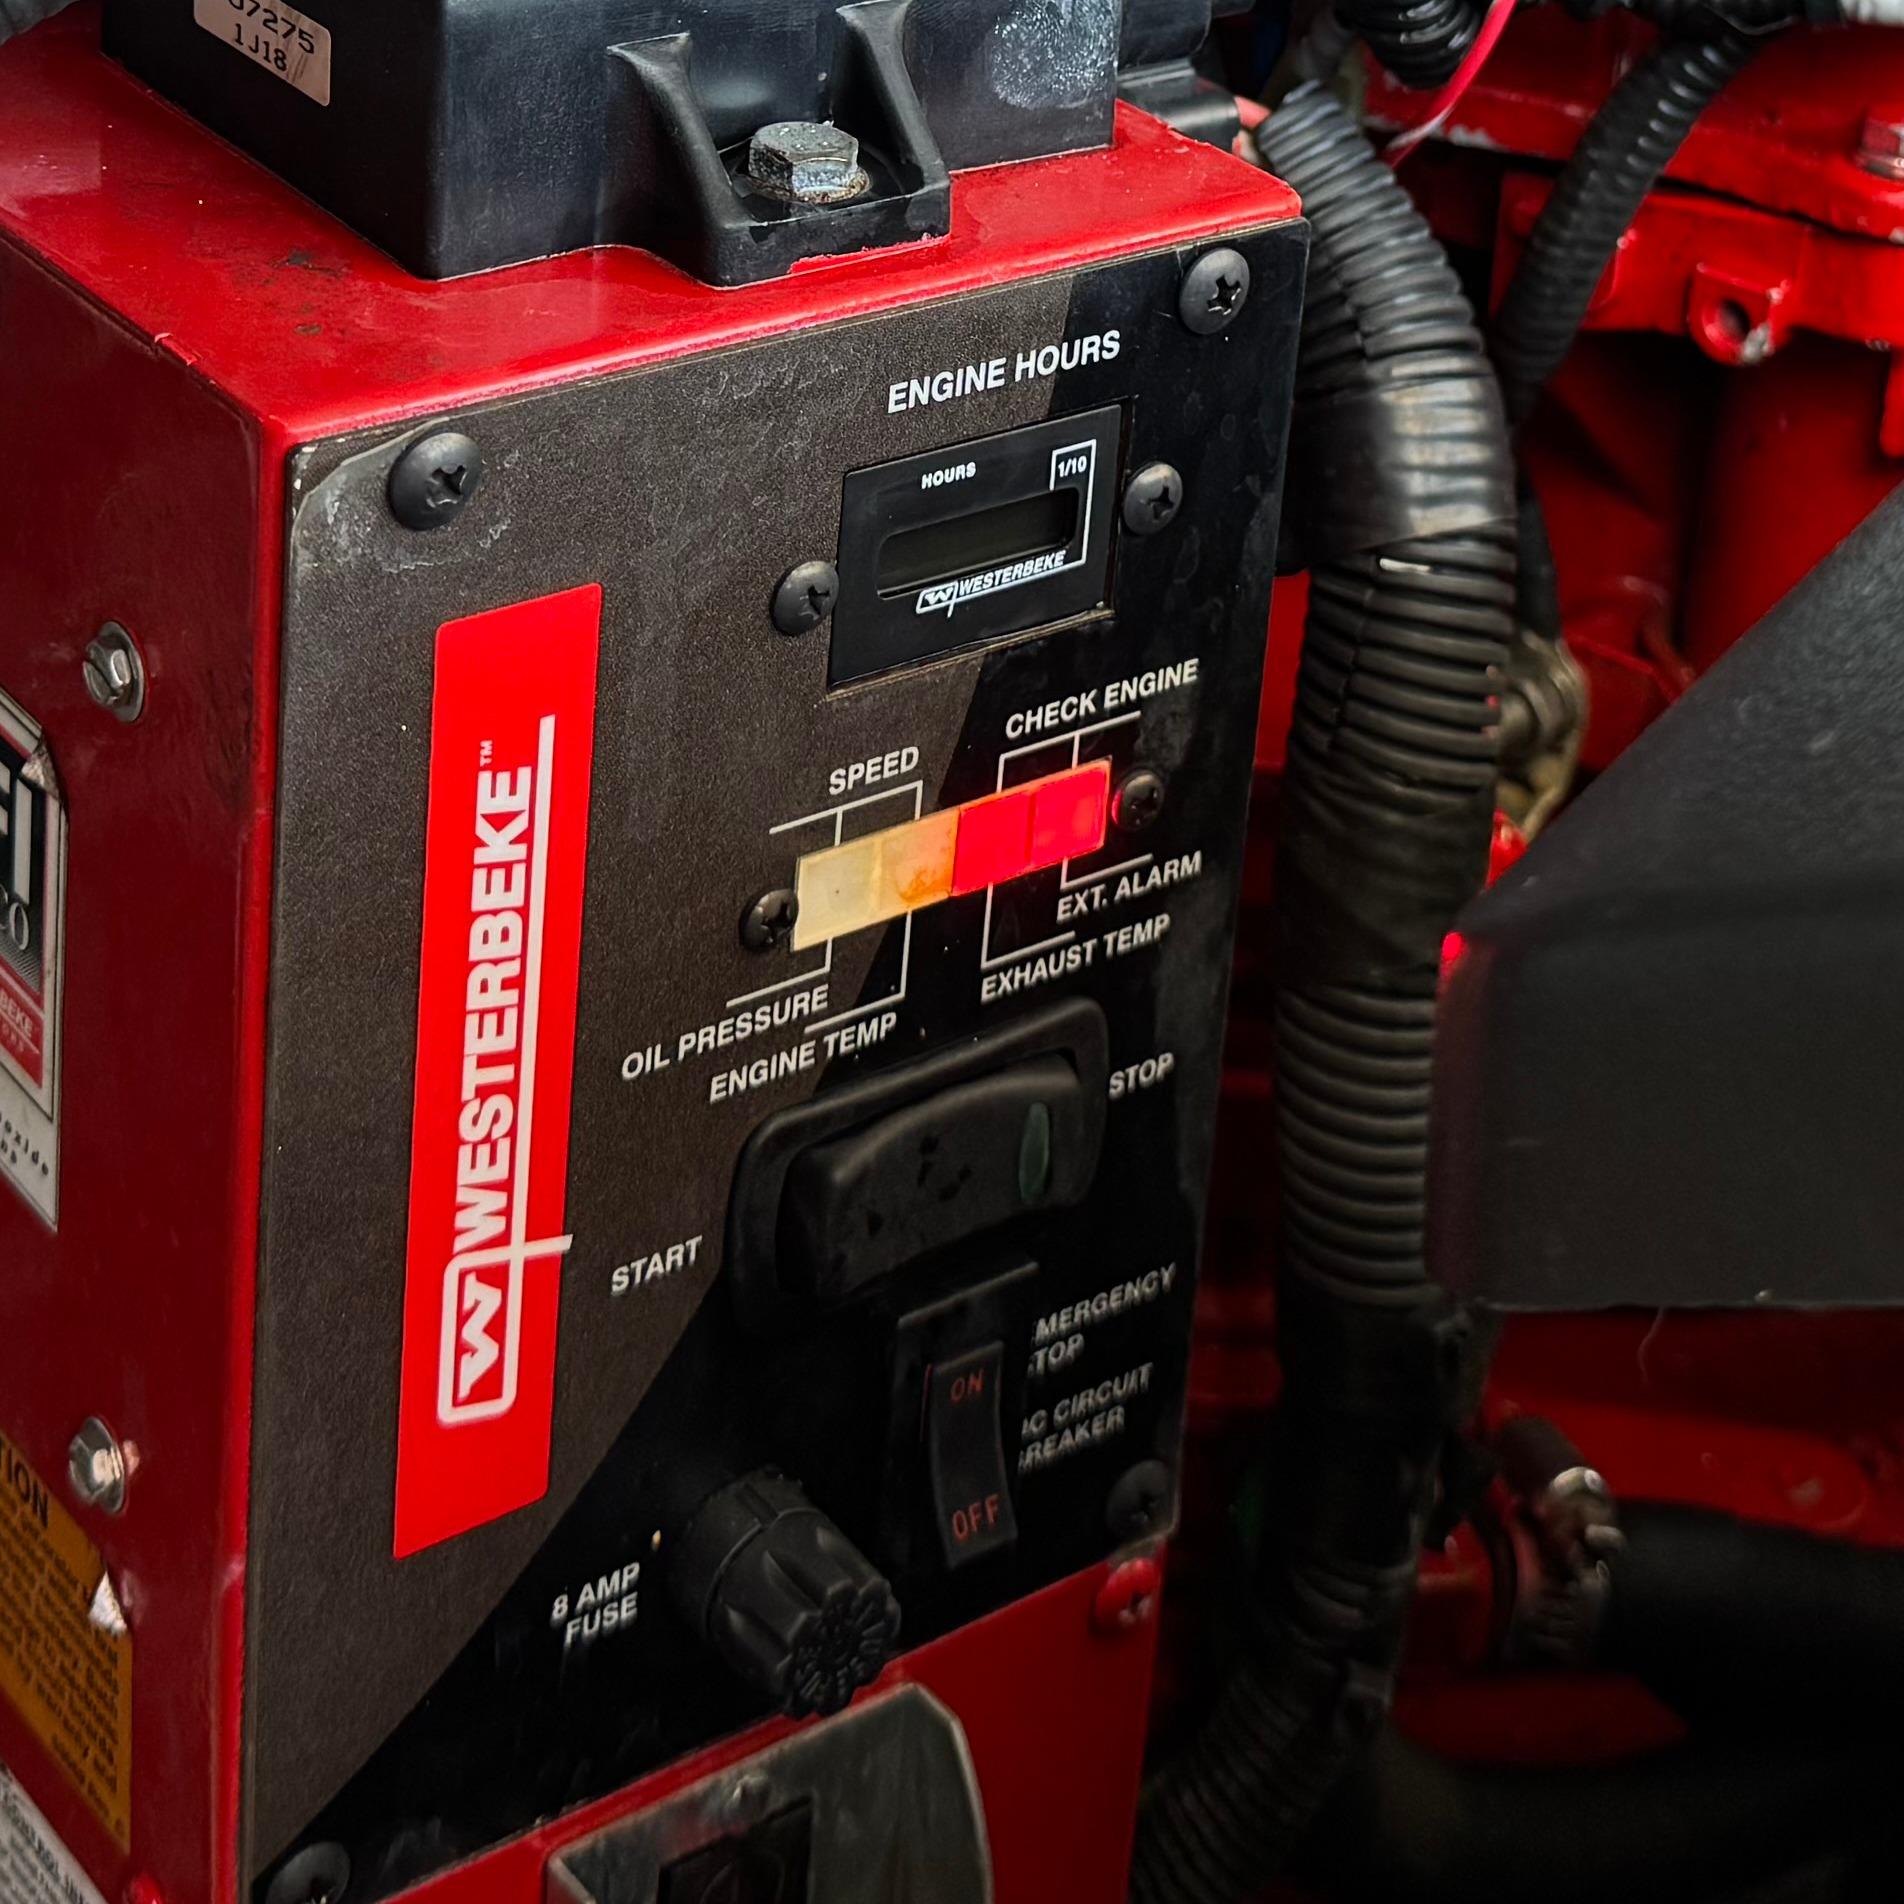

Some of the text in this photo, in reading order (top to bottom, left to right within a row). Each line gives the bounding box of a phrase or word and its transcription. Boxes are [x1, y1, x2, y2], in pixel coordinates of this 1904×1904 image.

[887, 329, 1121, 414] ENGINE HOURS
[921, 454, 1088, 489] HOURS 1/10
[959, 549, 1066, 597] WESTERBEKE
[1005, 657, 1200, 740] CHECK ENGINE
[828, 745, 920, 797] SPEED
[1056, 849, 1203, 925] EXT. ALARM
[980, 912, 1172, 1005] EXHAUST TEMP
[452, 763, 533, 1253] WESTERBEKE
[621, 983, 830, 1081] OIL PRESSURE
[709, 1011, 898, 1104] ENGINE TEMP
[1108, 1051, 1175, 1101] STOP
[610, 1234, 703, 1296] START
[1032, 1261, 1177, 1346] MERGENCY
[950, 1368, 985, 1404] ON
[1053, 1361, 1155, 1431] CIRCUIT
[952, 1492, 1000, 1542] OFF
[550, 1561, 641, 1626] 8 AMP
[565, 1591, 639, 1648] FUSE
